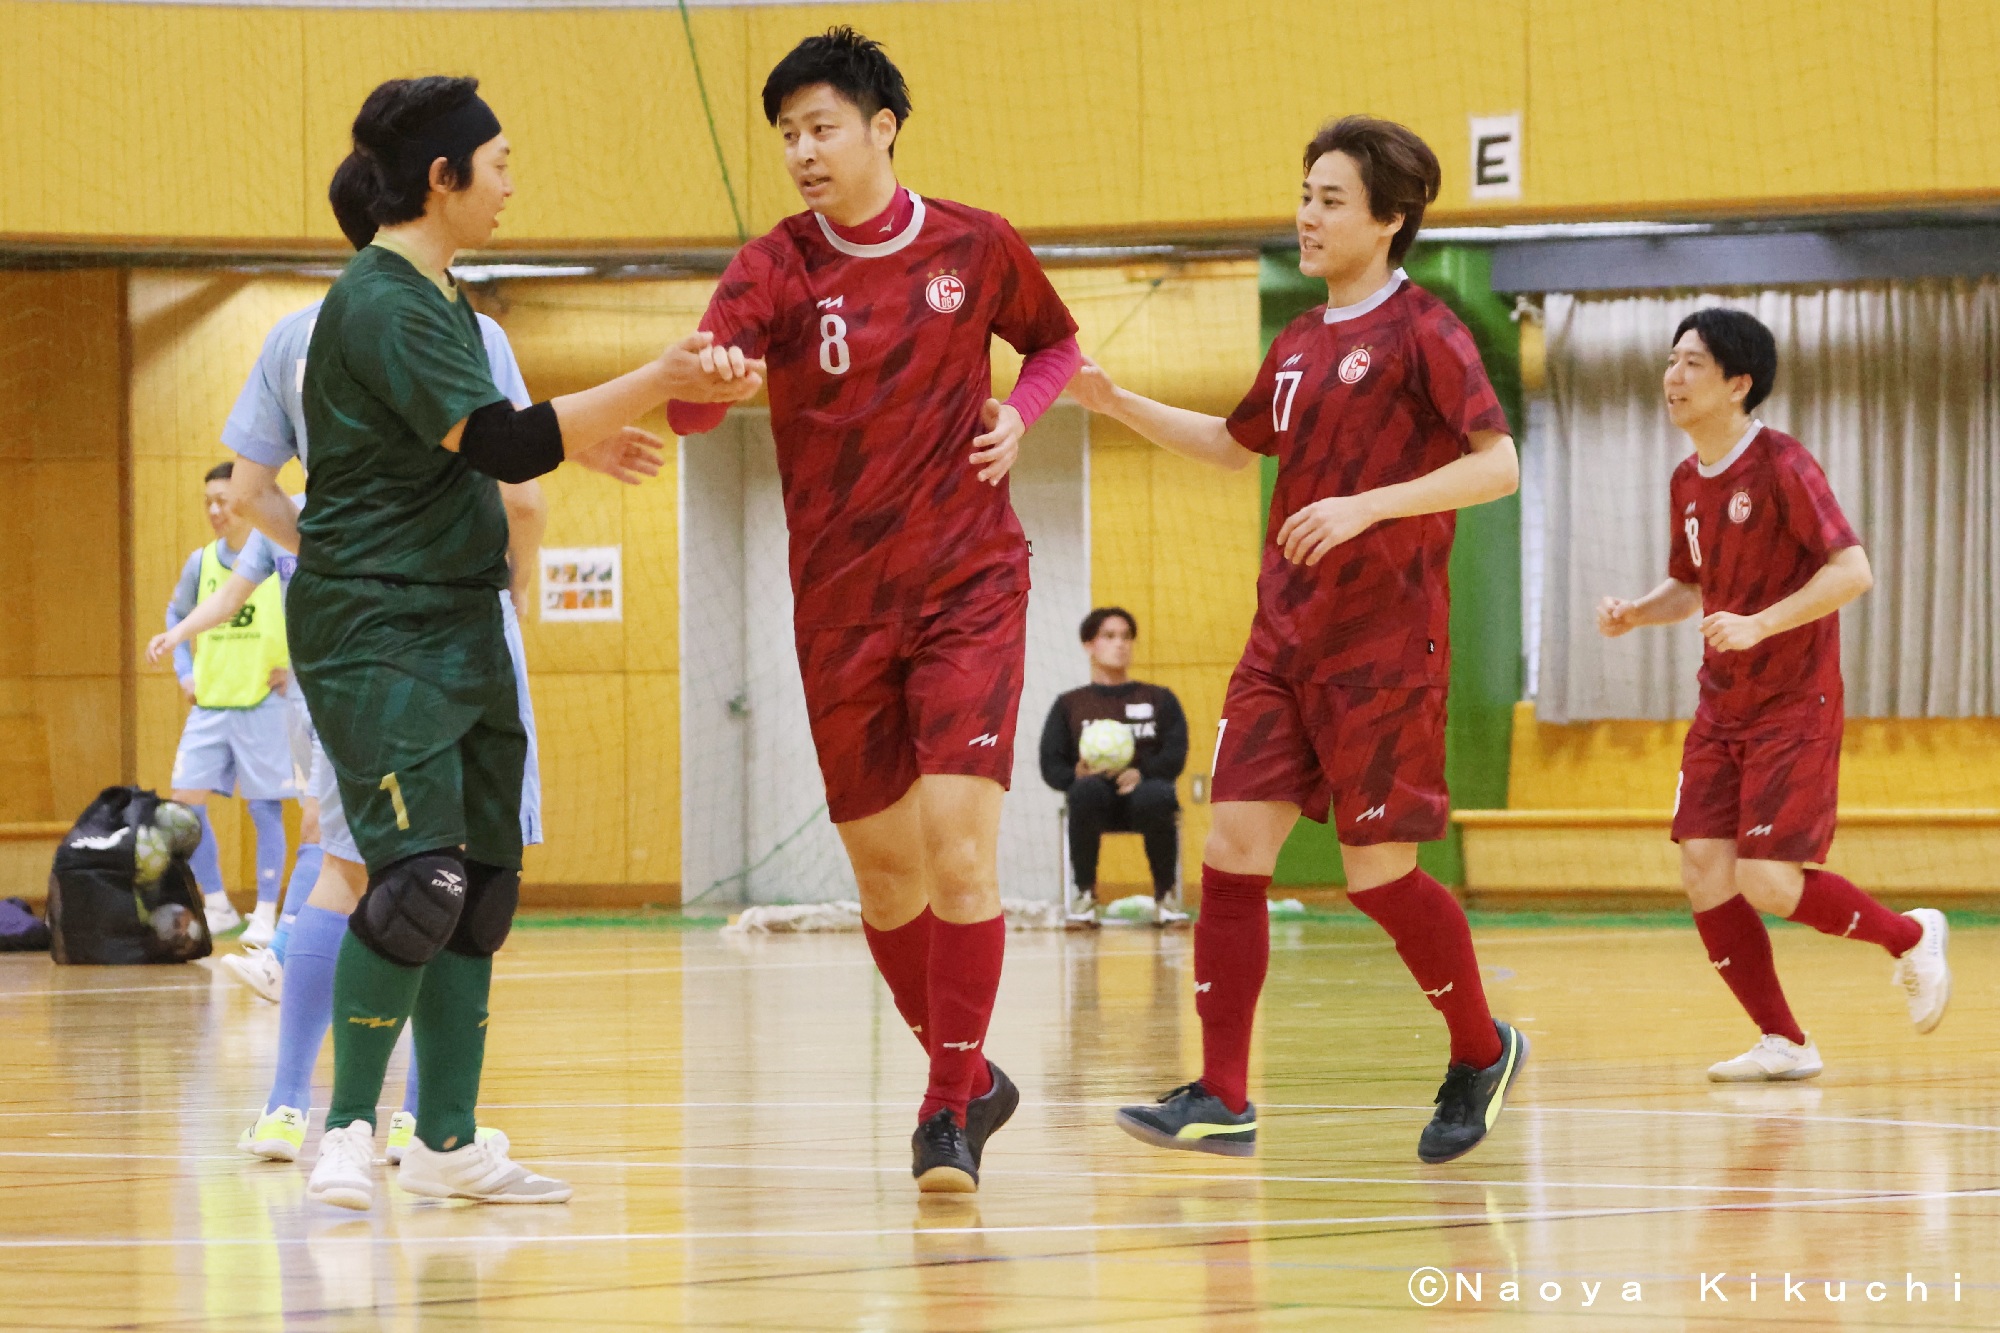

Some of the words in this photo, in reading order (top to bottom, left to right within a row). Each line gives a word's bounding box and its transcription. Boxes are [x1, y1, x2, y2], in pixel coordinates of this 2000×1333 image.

[1476, 134, 1511, 186] E
[819, 314, 850, 375] 8
[1272, 371, 1304, 433] 17
[379, 772, 410, 831] 1
